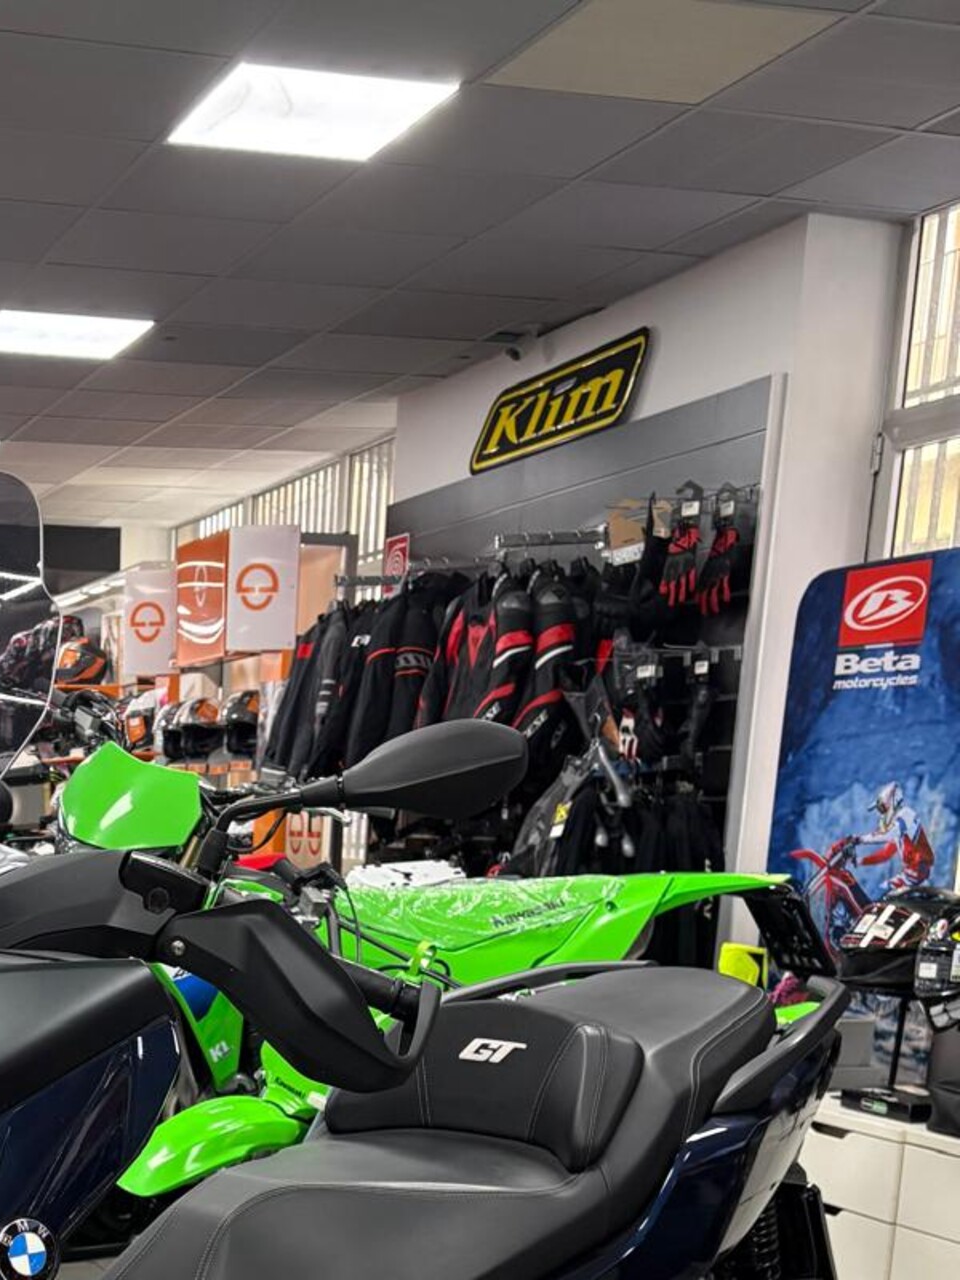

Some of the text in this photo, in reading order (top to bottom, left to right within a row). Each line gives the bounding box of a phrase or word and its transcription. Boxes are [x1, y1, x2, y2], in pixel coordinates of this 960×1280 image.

[482, 368, 625, 455] Klim
[834, 650, 921, 676] Beta
[832, 674, 919, 690] motorcycles
[459, 1037, 527, 1063] GT
